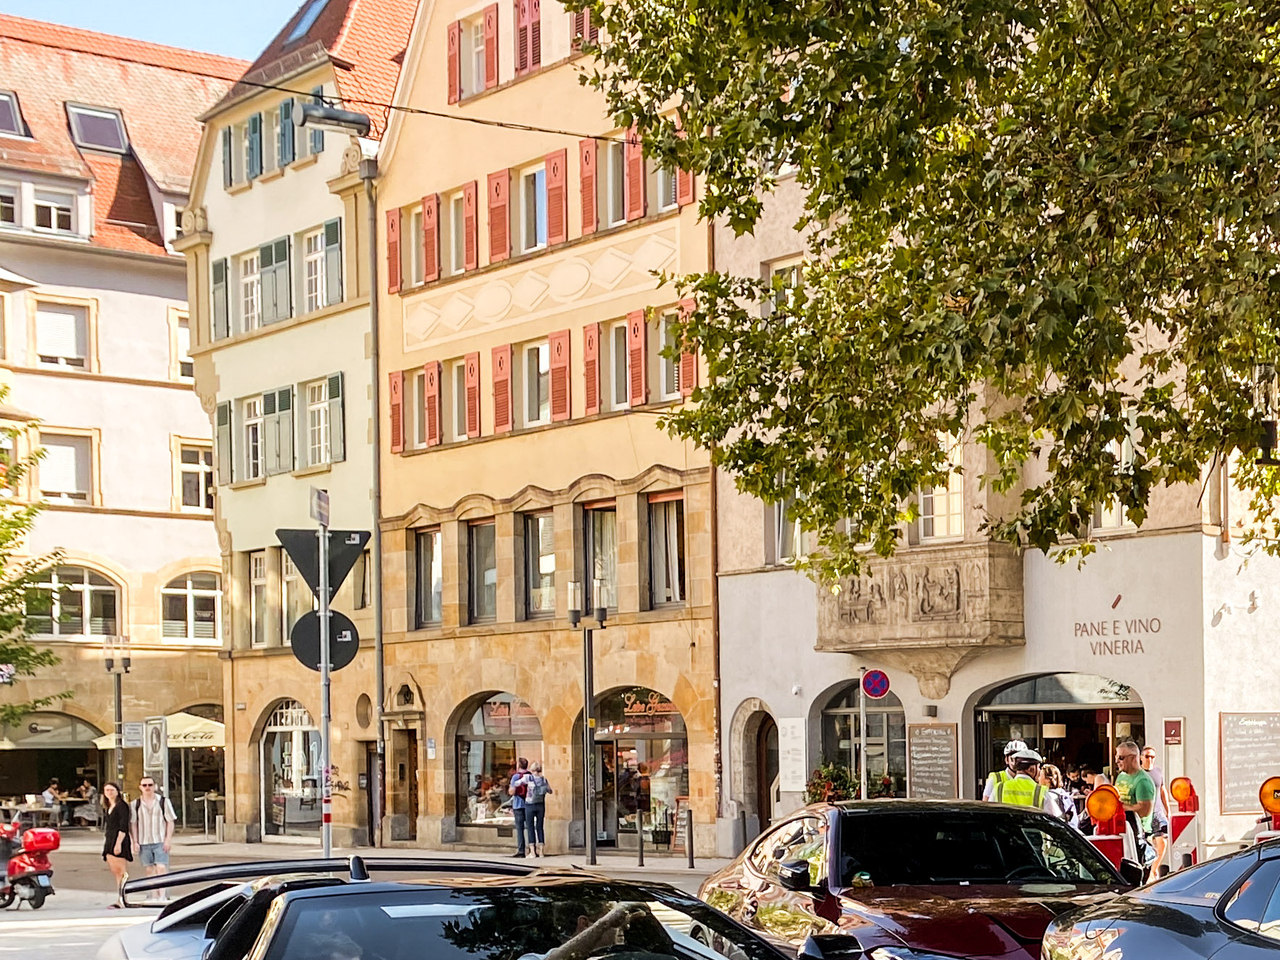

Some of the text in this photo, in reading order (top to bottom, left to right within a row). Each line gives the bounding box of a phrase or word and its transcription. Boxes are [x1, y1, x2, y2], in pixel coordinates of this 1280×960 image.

[1074, 618, 1161, 637] PANE E VINO
[1089, 639, 1145, 655] VINERIA
